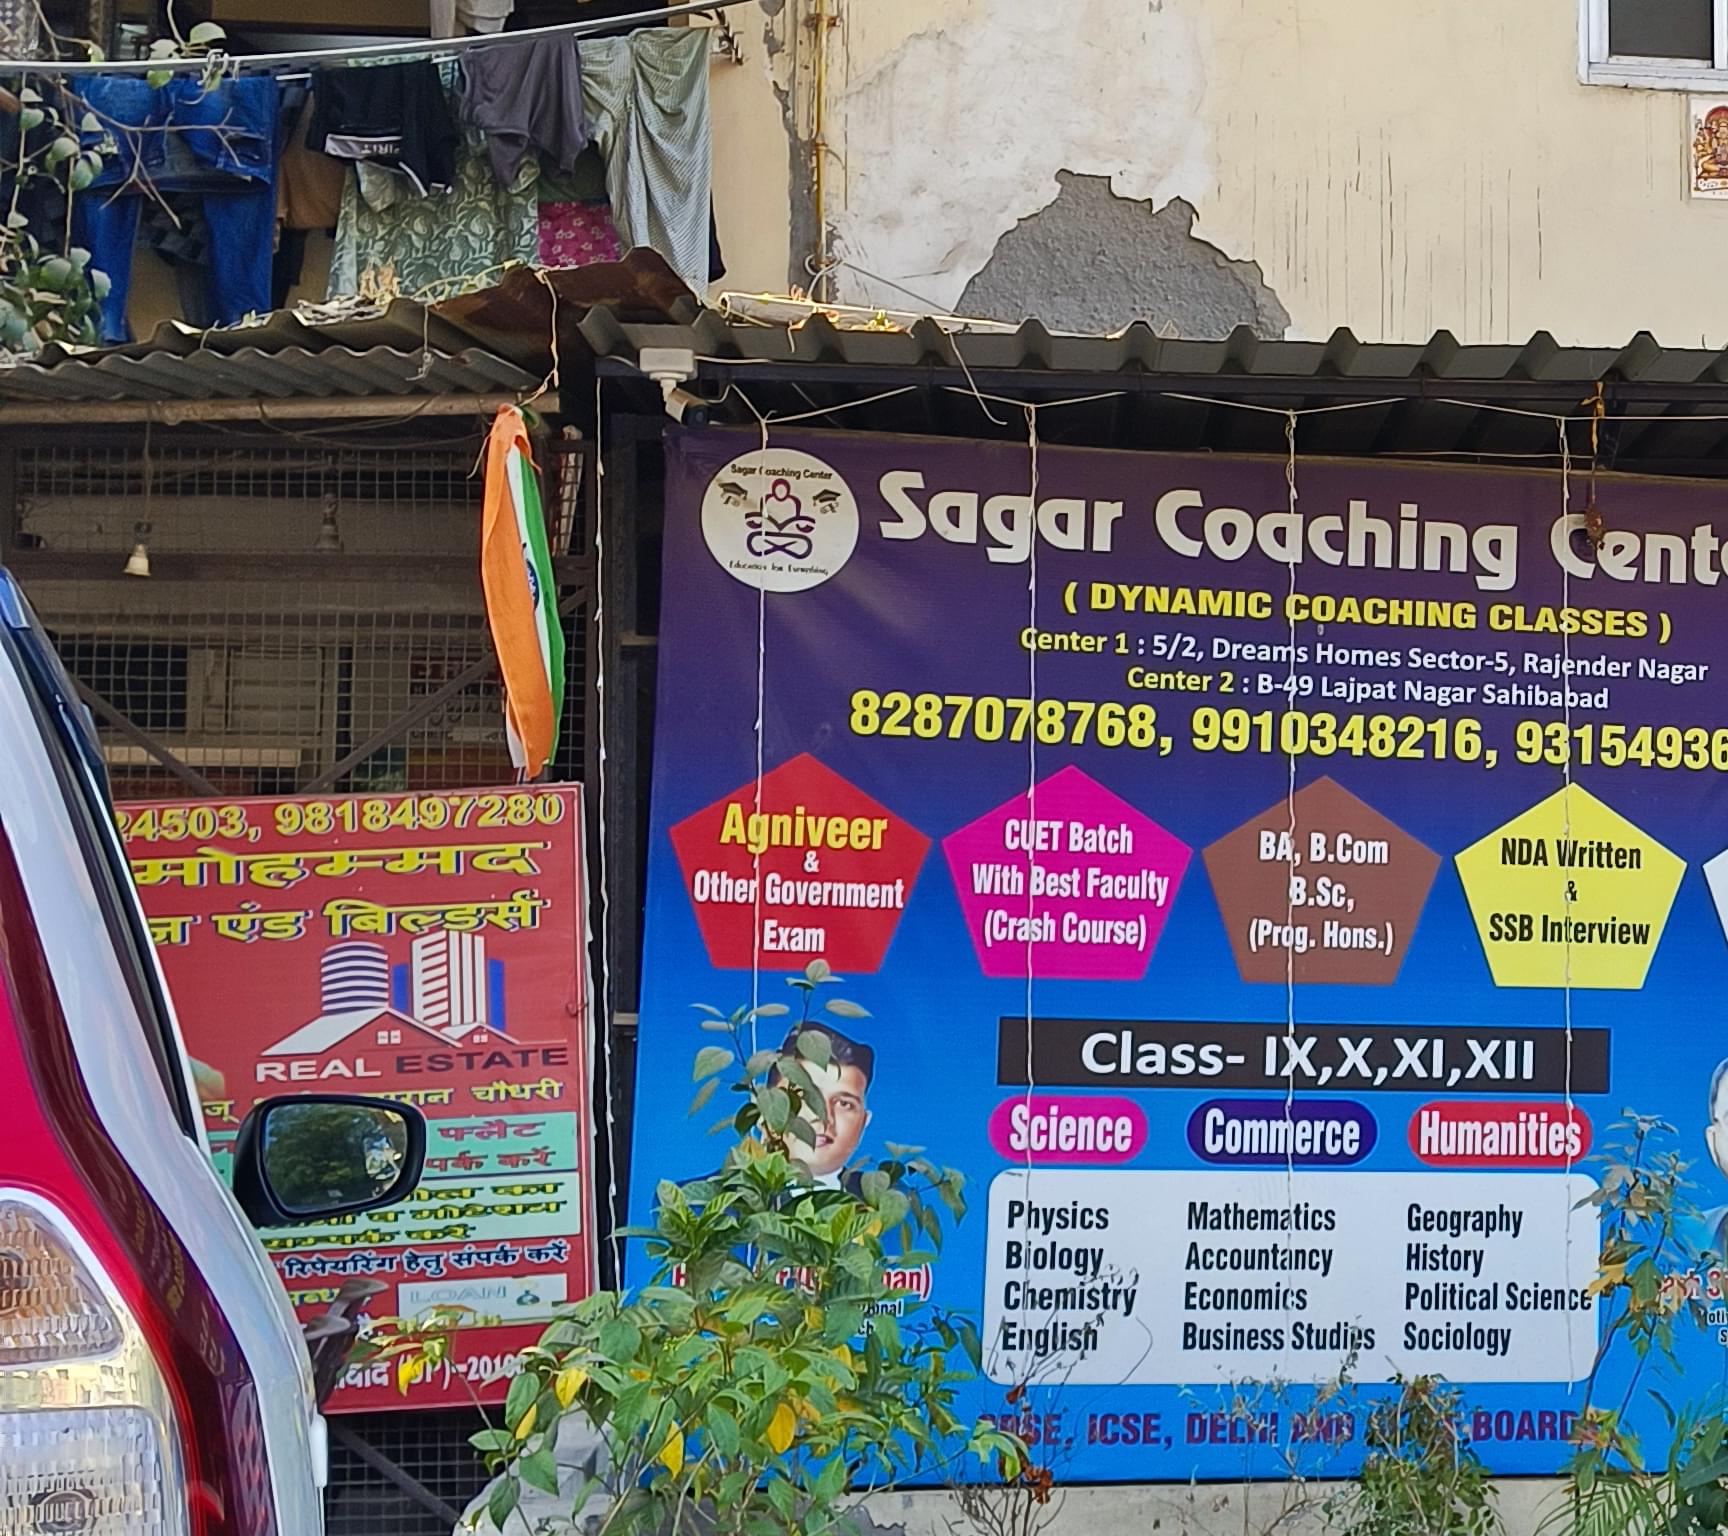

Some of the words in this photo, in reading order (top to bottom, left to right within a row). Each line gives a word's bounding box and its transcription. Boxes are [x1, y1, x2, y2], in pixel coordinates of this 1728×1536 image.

[879, 470, 1124, 563] Sagar
[1154, 489, 1518, 591] Coaching
[1090, 583, 1272, 619] DYNAMIC
[1285, 593, 1477, 630] COACHING
[1488, 605, 1648, 638] CLASSES
[1020, 628, 1107, 653] Center
[1115, 631, 1129, 653] 1
[1152, 633, 1204, 663] 5/2,
[1212, 638, 1308, 663] Dreams
[1315, 642, 1401, 668] Homes
[1407, 646, 1516, 677] Sector-5,
[1523, 652, 1632, 682] Rajender
[1638, 658, 1709, 687] Nagar
[1126, 666, 1212, 692] Center
[1219, 670, 1234, 693] 2
[1256, 672, 1313, 698] B-49
[1321, 677, 1397, 704] Lajpat
[1403, 680, 1476, 707] Nagar
[1482, 683, 1609, 710] Sahibabad
[849, 689, 1173, 757] 8287078768,
[1192, 706, 1498, 768] 9910348216,
[275, 793, 563, 836] 9818497280
[719, 802, 887, 854] Agniveer
[1004, 818, 1062, 853] CUET
[1068, 823, 1133, 854] Batch
[1259, 831, 1301, 867] BA,
[1309, 834, 1389, 865] B.Com
[1500, 837, 1549, 867] NDA
[1557, 839, 1643, 870] Written
[803, 850, 820, 873] &
[694, 870, 757, 905] Other
[764, 877, 904, 909] Government
[972, 863, 1024, 896] With
[1030, 868, 1081, 899] Best
[1086, 869, 1169, 907] Faculty
[1289, 877, 1355, 913] B.Sc,
[762, 919, 825, 953] Exam
[983, 910, 1055, 946] (Crash
[1062, 914, 1148, 952] Course)
[1248, 919, 1316, 955] (Prog.
[1323, 923, 1395, 956] Hons.)
[1489, 912, 1534, 943] SSB
[1541, 915, 1651, 946] Interview
[255, 1056, 381, 1083] REAL
[394, 1046, 569, 1074] ESTATE
[1081, 1030, 1245, 1077] Class-
[1264, 1035, 1535, 1085] IX,X,XI,XII
[1008, 1109, 1132, 1154] Science
[1204, 1106, 1361, 1157] Commerce
[1419, 1110, 1582, 1158] Humanities
[1007, 1200, 1109, 1235] Physics
[1187, 1201, 1336, 1233] Mathematics
[1407, 1204, 1523, 1238] Geography
[525, 1239, 571, 1262] करें
[1005, 1241, 1104, 1277] Biology
[1185, 1242, 1334, 1275] Accountancy
[1406, 1244, 1484, 1278] History
[1003, 1281, 1136, 1317] Chemistry
[1184, 1282, 1307, 1311] Economics
[1405, 1283, 1500, 1312] Political
[1505, 1283, 1593, 1312] Science
[1002, 1321, 1098, 1357] English
[1182, 1322, 1287, 1352] Business
[1291, 1321, 1376, 1353] Studies
[1403, 1322, 1512, 1357] Sociology
[1088, 1413, 1173, 1451] ICSE,
